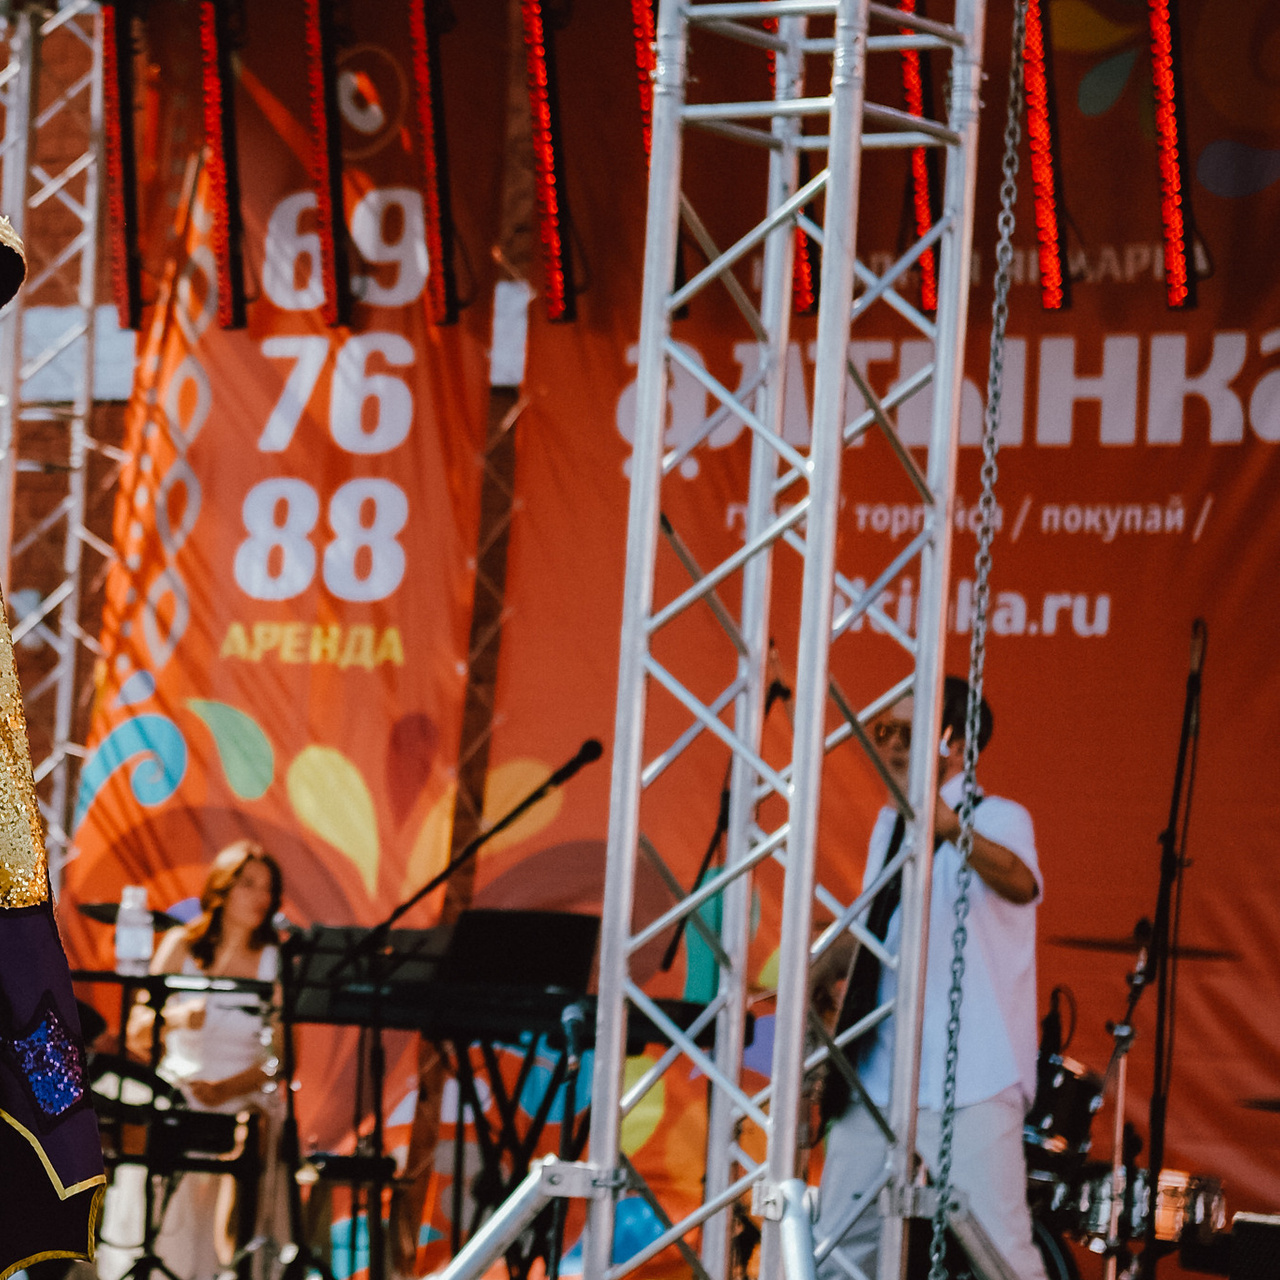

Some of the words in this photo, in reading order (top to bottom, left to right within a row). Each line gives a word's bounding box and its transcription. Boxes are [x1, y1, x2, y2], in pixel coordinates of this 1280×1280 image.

[263, 187, 430, 311] 69
[257, 332, 416, 455] 76
[233, 477, 409, 602] 88
[1040, 494, 1185, 544] покупай
[221, 622, 404, 672] АРЕНДА
